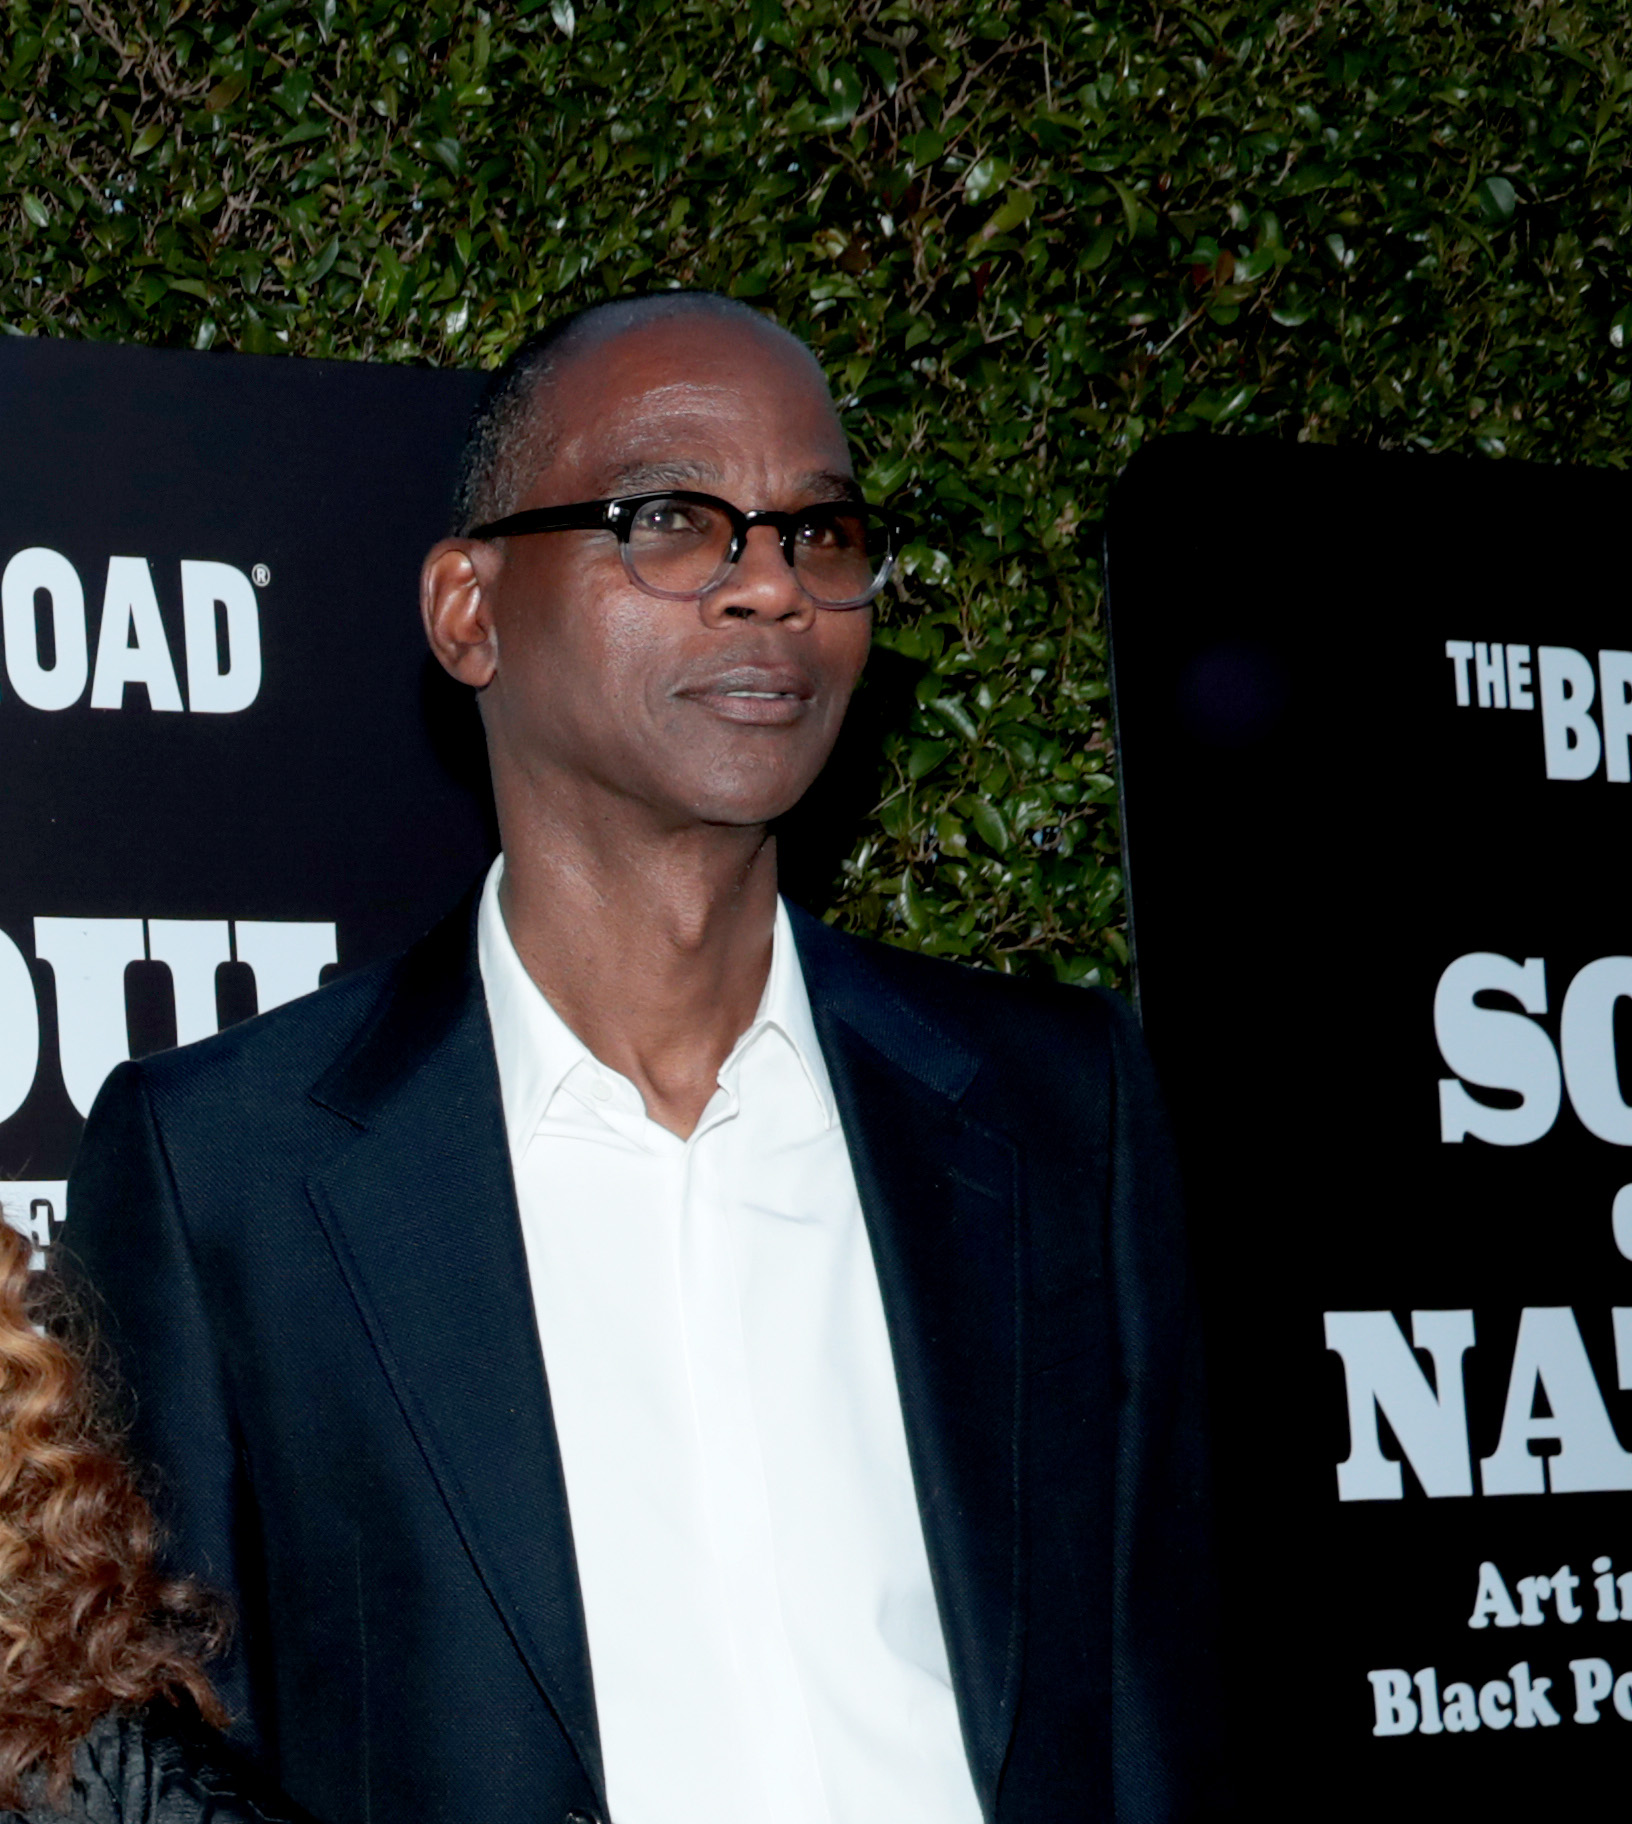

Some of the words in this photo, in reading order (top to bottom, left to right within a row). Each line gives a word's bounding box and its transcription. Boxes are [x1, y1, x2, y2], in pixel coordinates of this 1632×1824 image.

[1445, 640, 1534, 710] THE
[1324, 1307, 1632, 1501] NA
[1468, 1562, 1582, 1628] Art
[1367, 1661, 1561, 1737] Black
